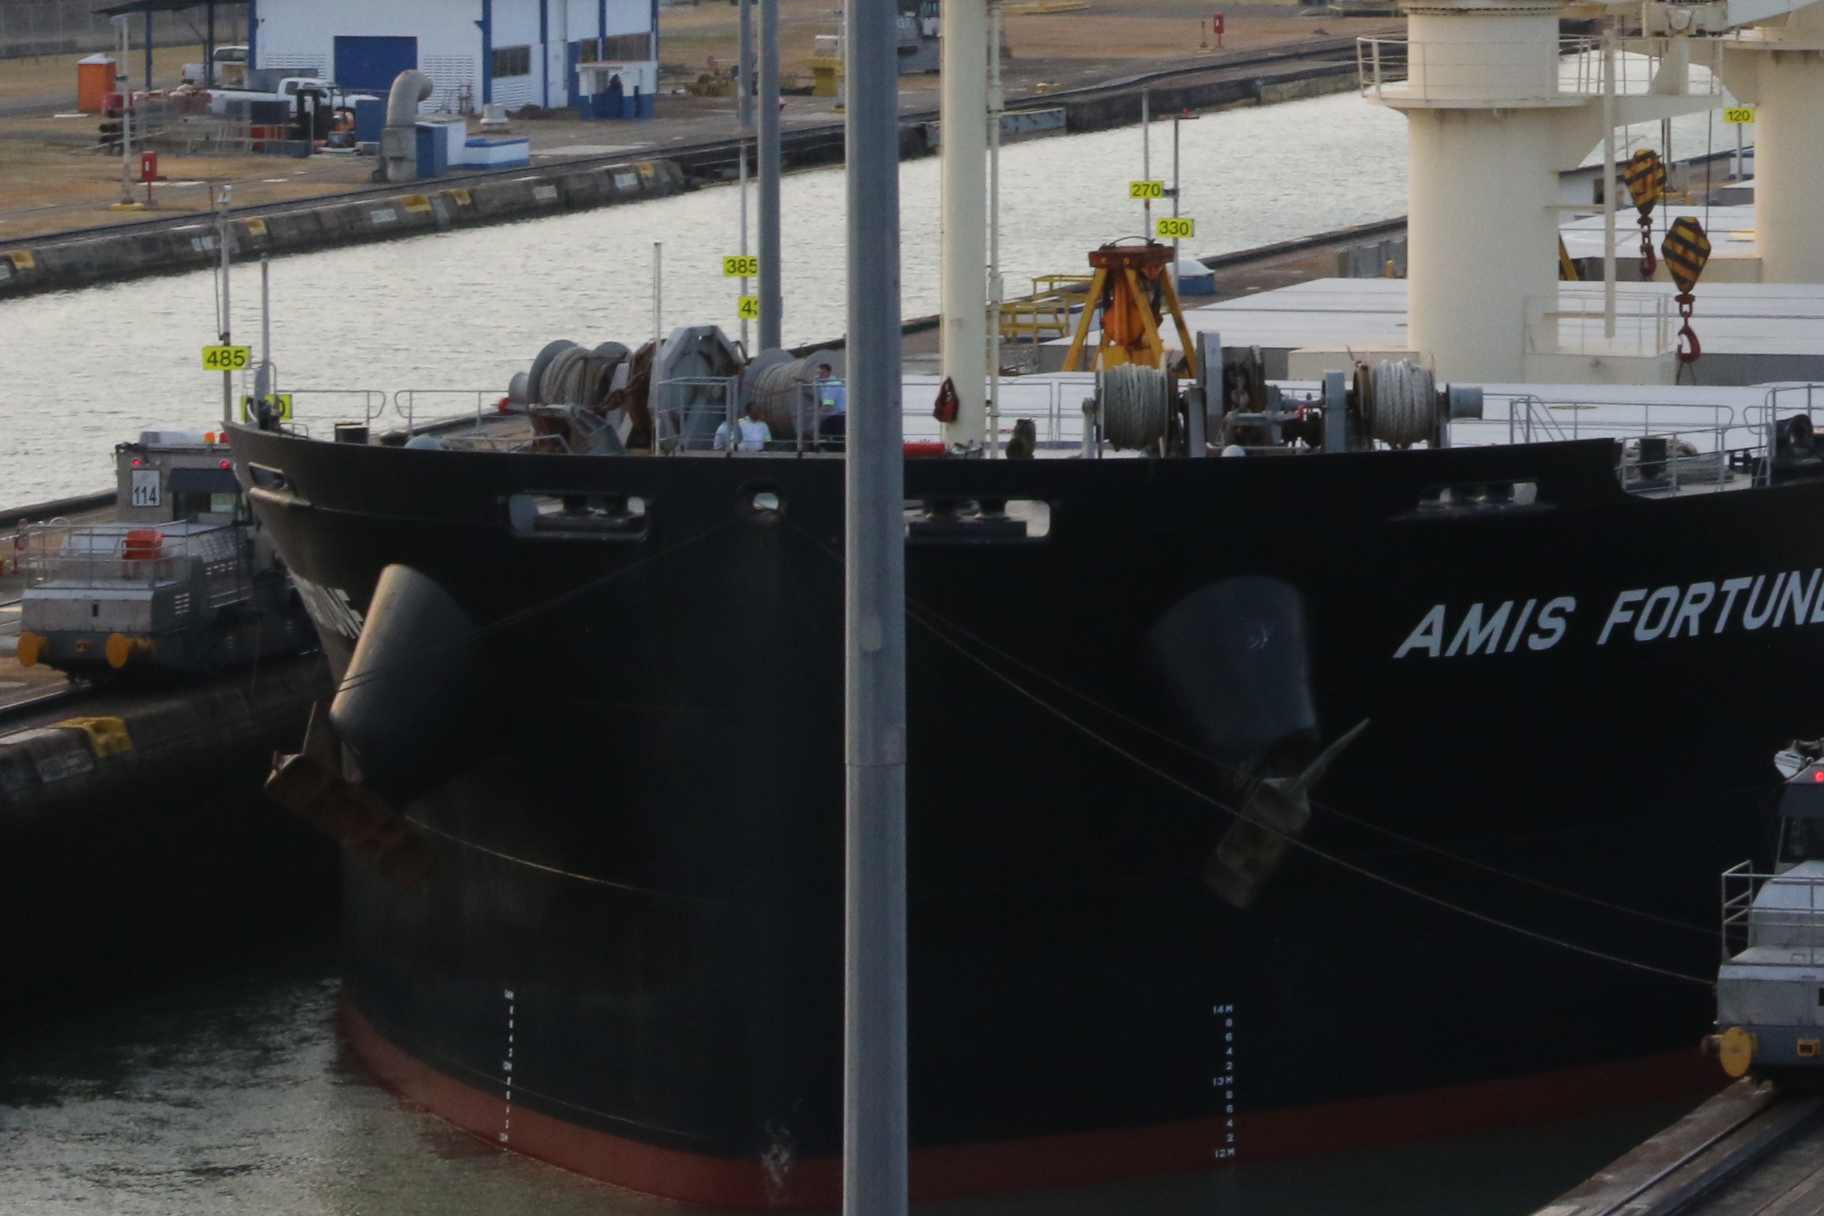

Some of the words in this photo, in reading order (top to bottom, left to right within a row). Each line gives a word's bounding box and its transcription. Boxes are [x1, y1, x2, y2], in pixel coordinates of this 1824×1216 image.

[1728, 109, 1751, 122] 120
[1131, 183, 1161, 197] 270
[1159, 220, 1190, 236] 330
[726, 258, 758, 274] 385
[206, 349, 246, 367] 485
[134, 485, 158, 505] 114
[1393, 595, 1577, 659] AMIS
